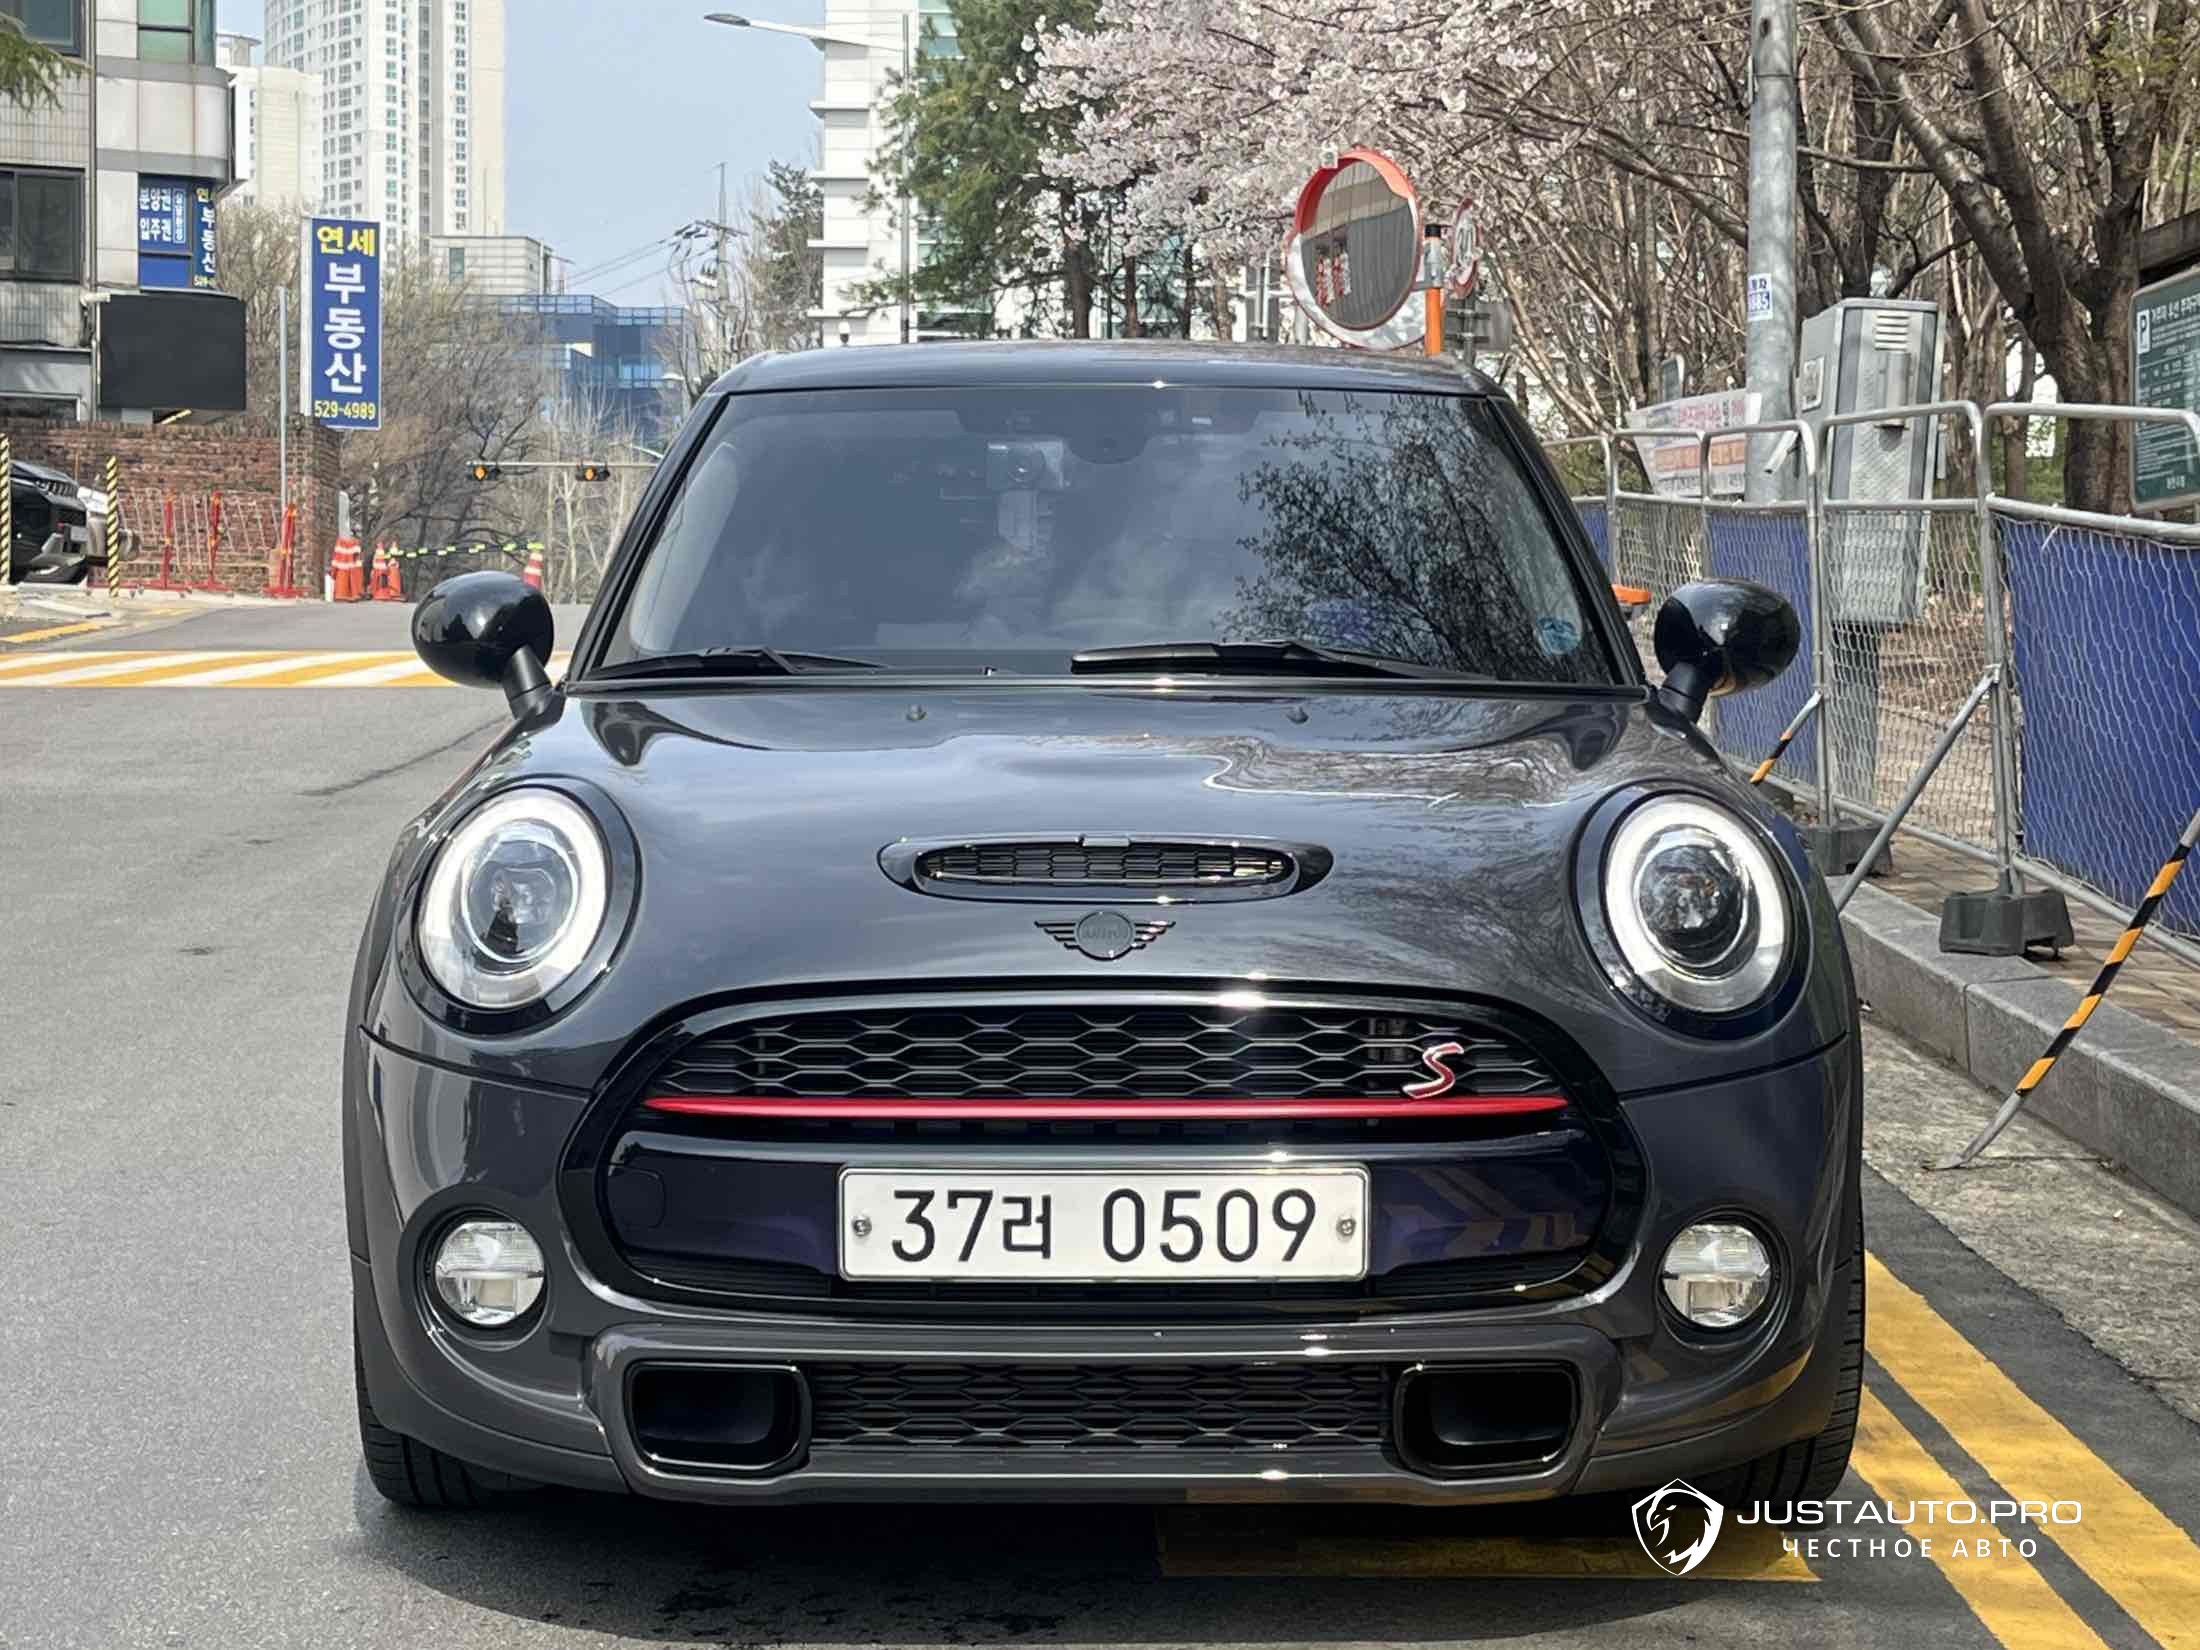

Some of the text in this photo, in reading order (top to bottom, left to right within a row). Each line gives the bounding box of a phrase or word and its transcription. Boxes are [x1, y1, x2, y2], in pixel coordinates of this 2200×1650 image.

[316, 226, 375, 257] 연세
[324, 262, 367, 394] 부동산
[314, 400, 376, 420] 529-4989
[1402, 1042, 1465, 1099] S
[891, 1187, 1317, 1263] 37러 0509
